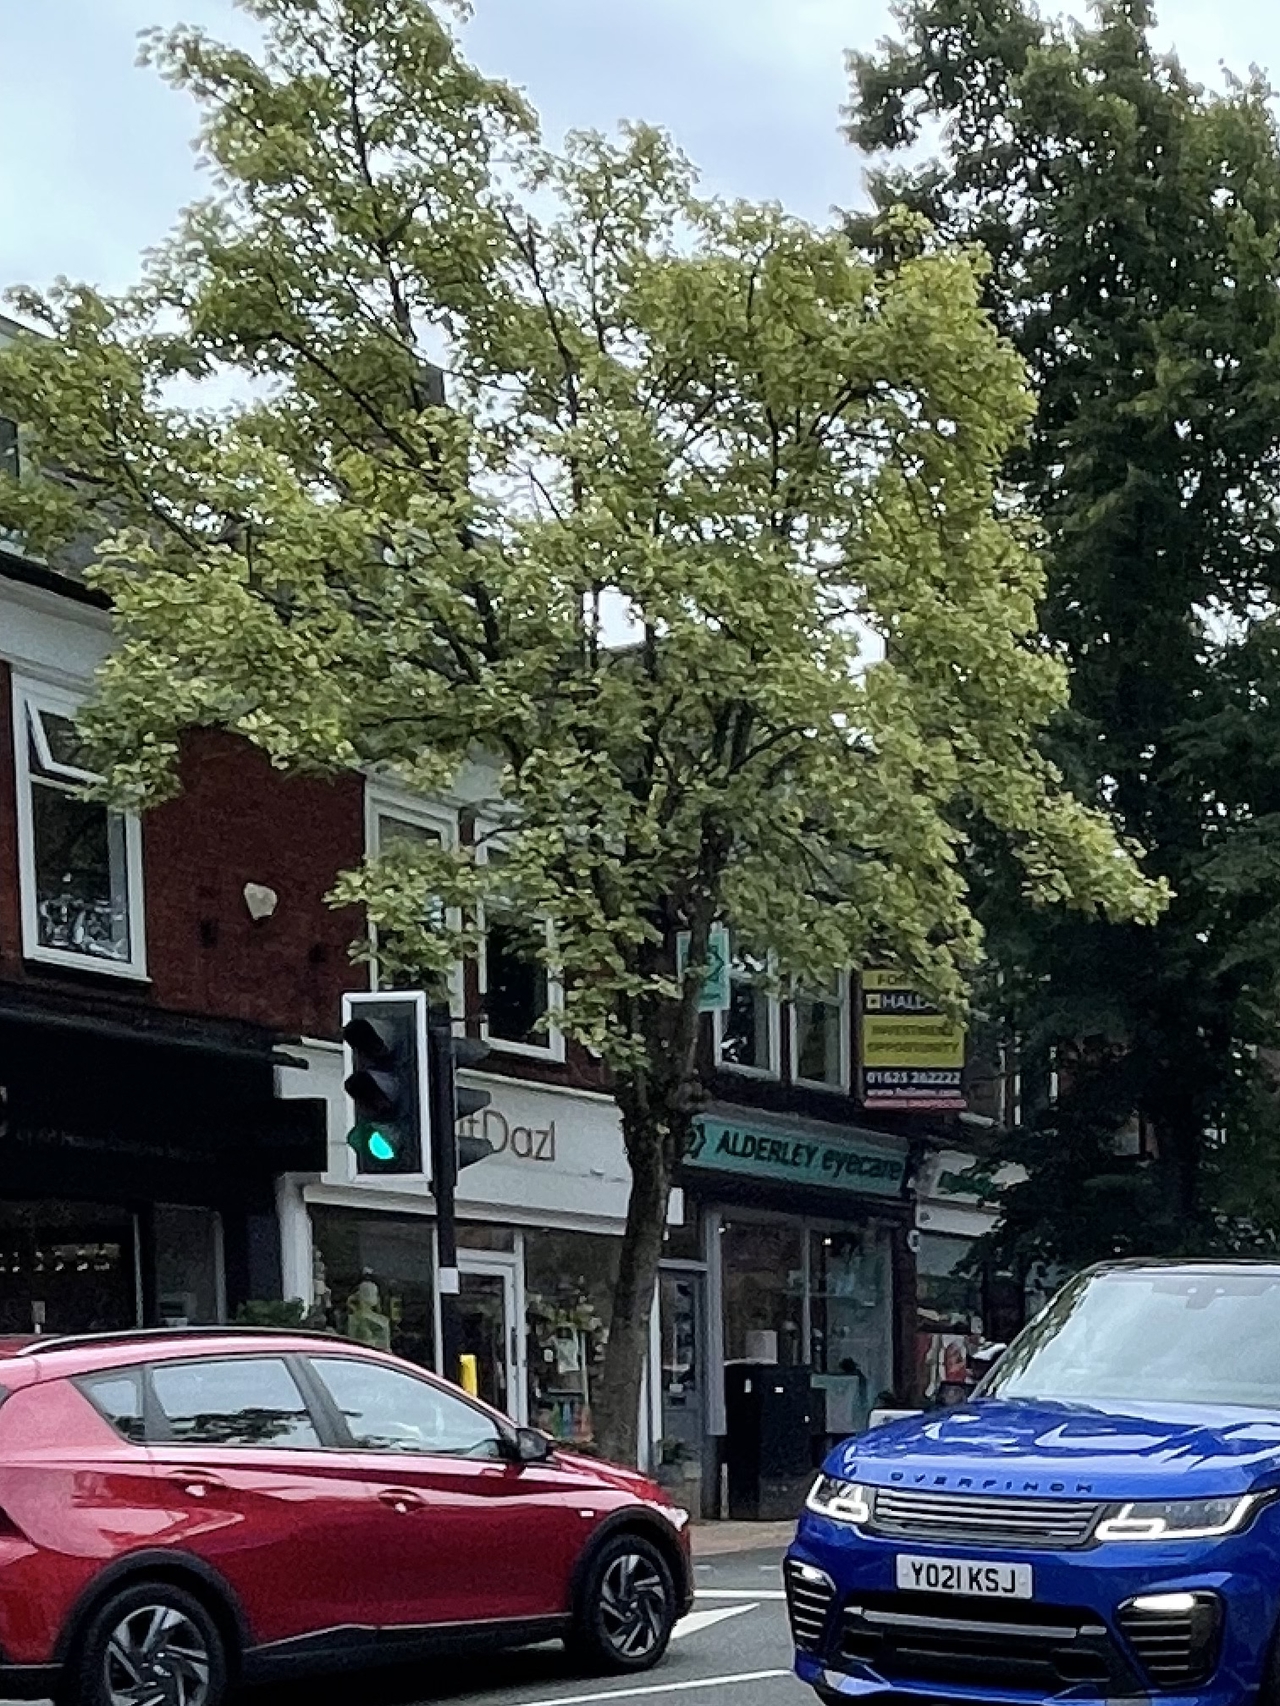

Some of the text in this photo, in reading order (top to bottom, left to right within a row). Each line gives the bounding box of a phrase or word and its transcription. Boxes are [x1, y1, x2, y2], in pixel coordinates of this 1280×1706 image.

[866, 1071, 908, 1084] 01625
[717, 1130, 903, 1181] ALDERLEY eyecare
[890, 1471, 1093, 1493] OVERFINCH
[967, 1565, 1016, 1594] KSJ
